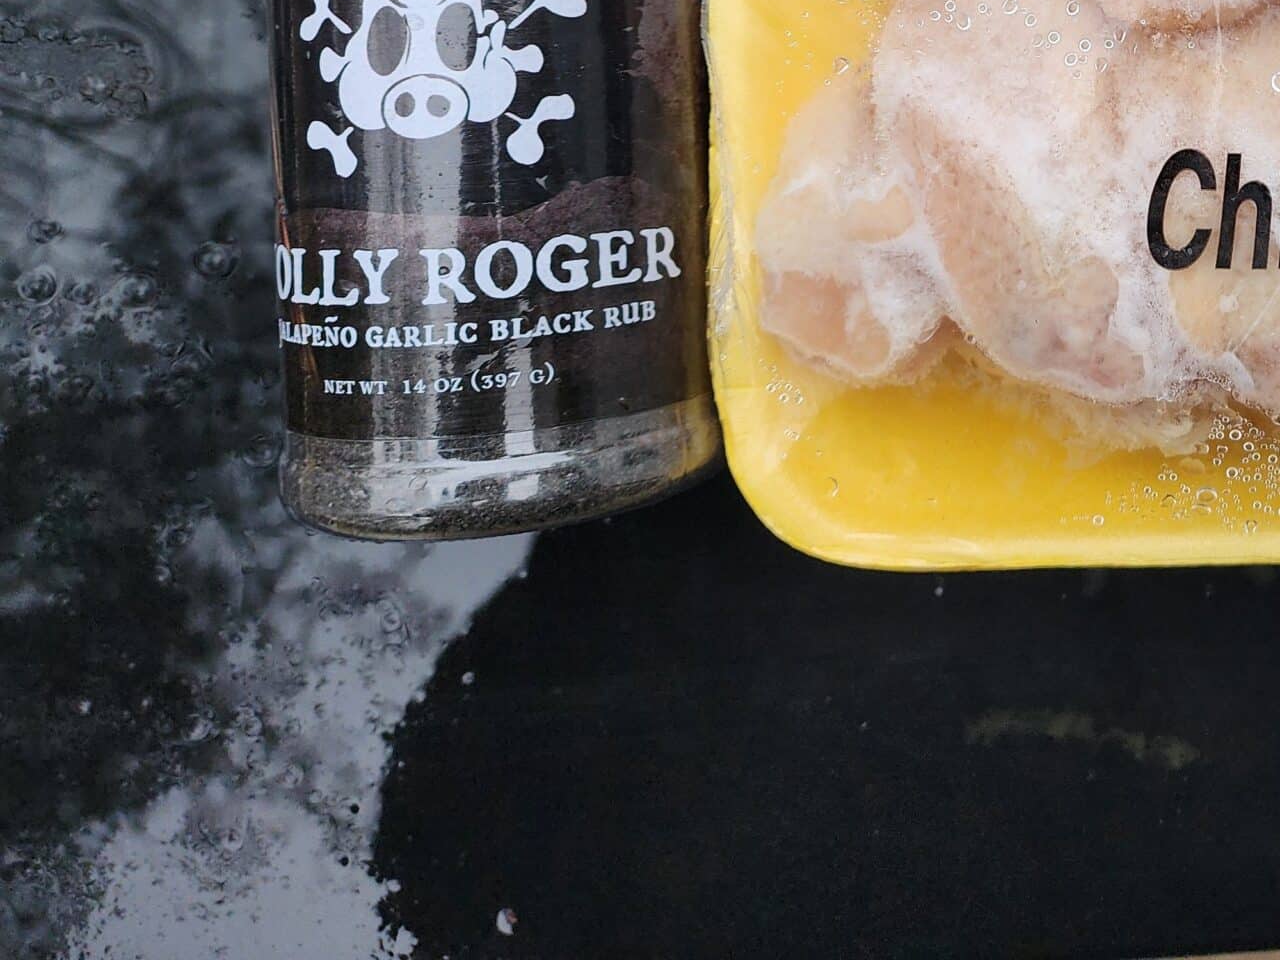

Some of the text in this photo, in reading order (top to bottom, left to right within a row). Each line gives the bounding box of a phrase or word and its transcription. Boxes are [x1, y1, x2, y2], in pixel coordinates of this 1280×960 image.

[275, 226, 682, 306] OLLY ROGER
[365, 322, 478, 348] GARLIC
[489, 309, 594, 342] BLACK
[603, 300, 657, 329] RUB
[324, 361, 555, 394] NET WT 14 OZ (397 G)
